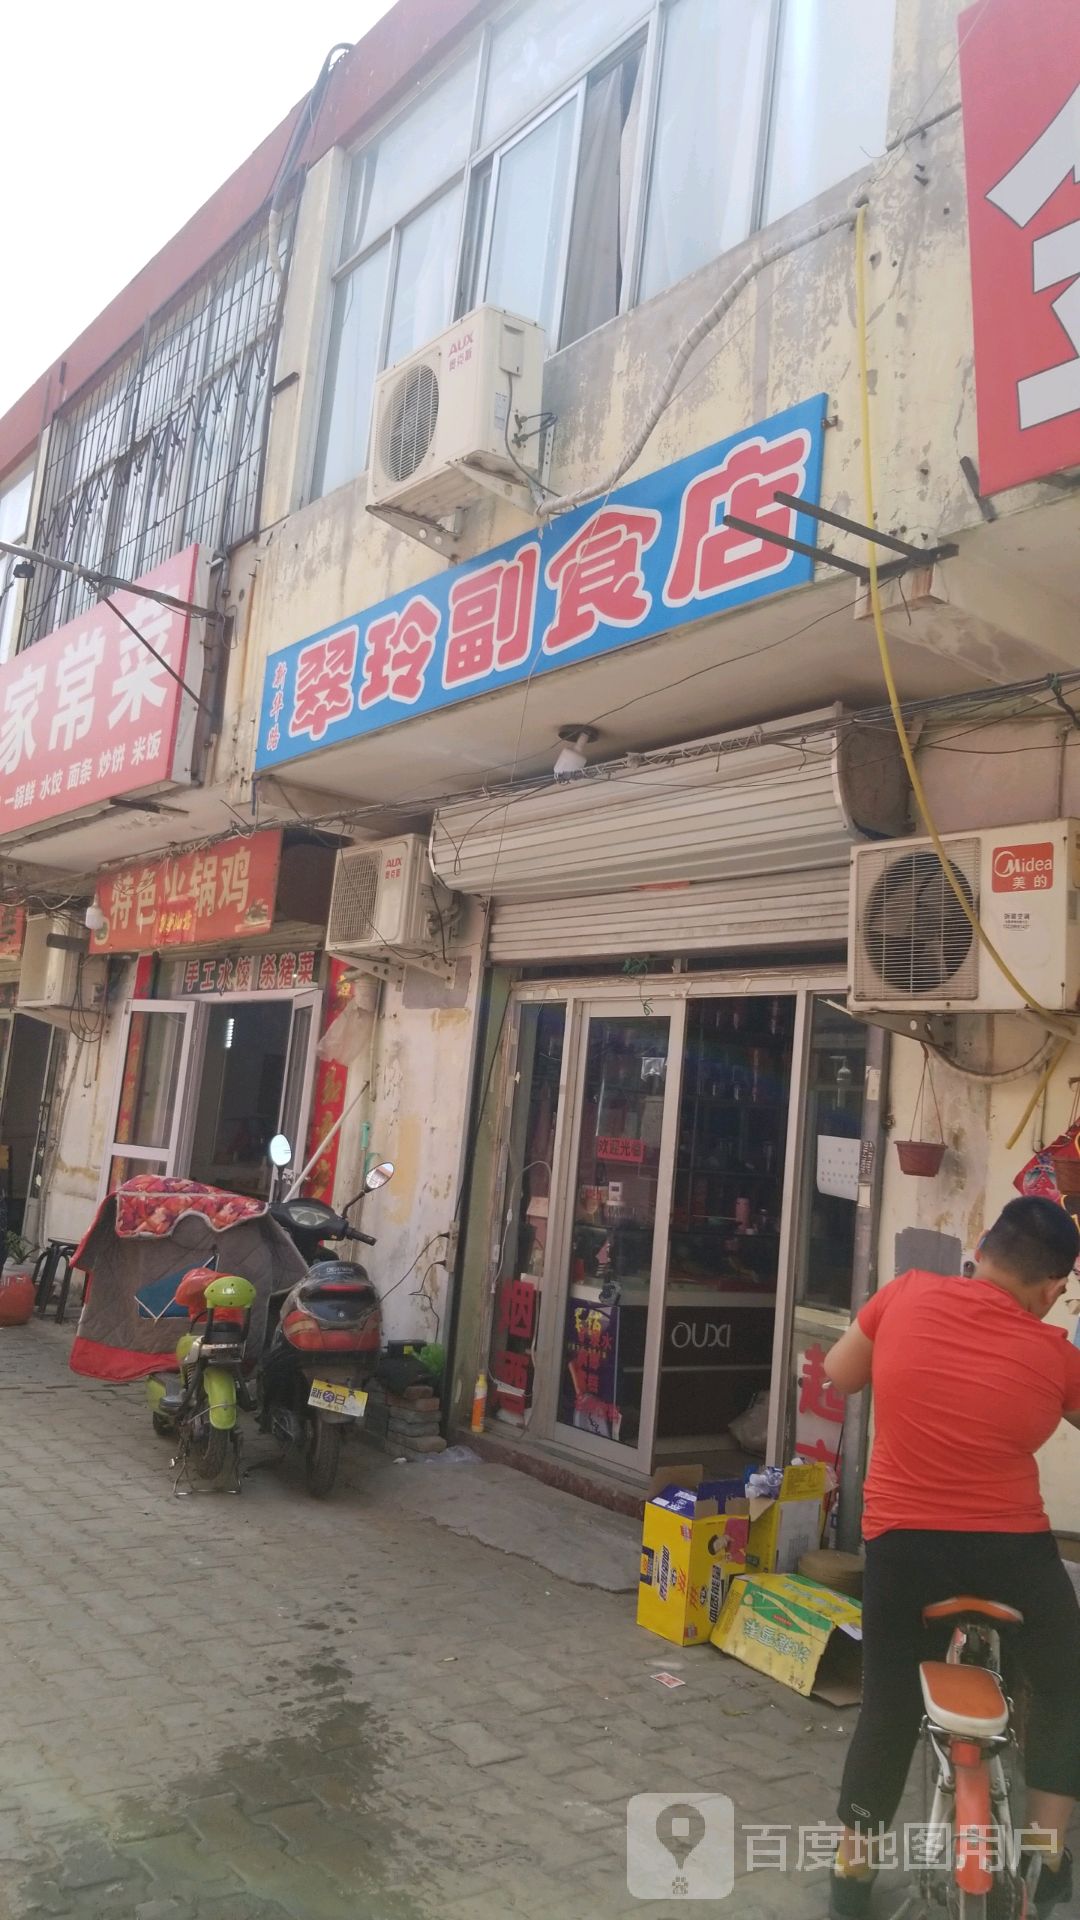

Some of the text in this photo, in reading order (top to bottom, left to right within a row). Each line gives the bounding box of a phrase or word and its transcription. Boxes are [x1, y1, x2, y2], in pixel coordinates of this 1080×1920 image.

[449, 332, 473, 356] AUX
[289, 428, 811, 739] 翠玲副食店
[0, 584, 179, 776] 家常菜
[39, 768, 63, 800] 水饺
[67, 757, 93, 792] 面条
[97, 743, 125, 780] 炒饼
[130, 729, 162, 766] 米饭
[1012, 875, 1048, 889] 美的
[184, 957, 250, 993] 手工水饺
[260, 950, 316, 991] 杀猪菜
